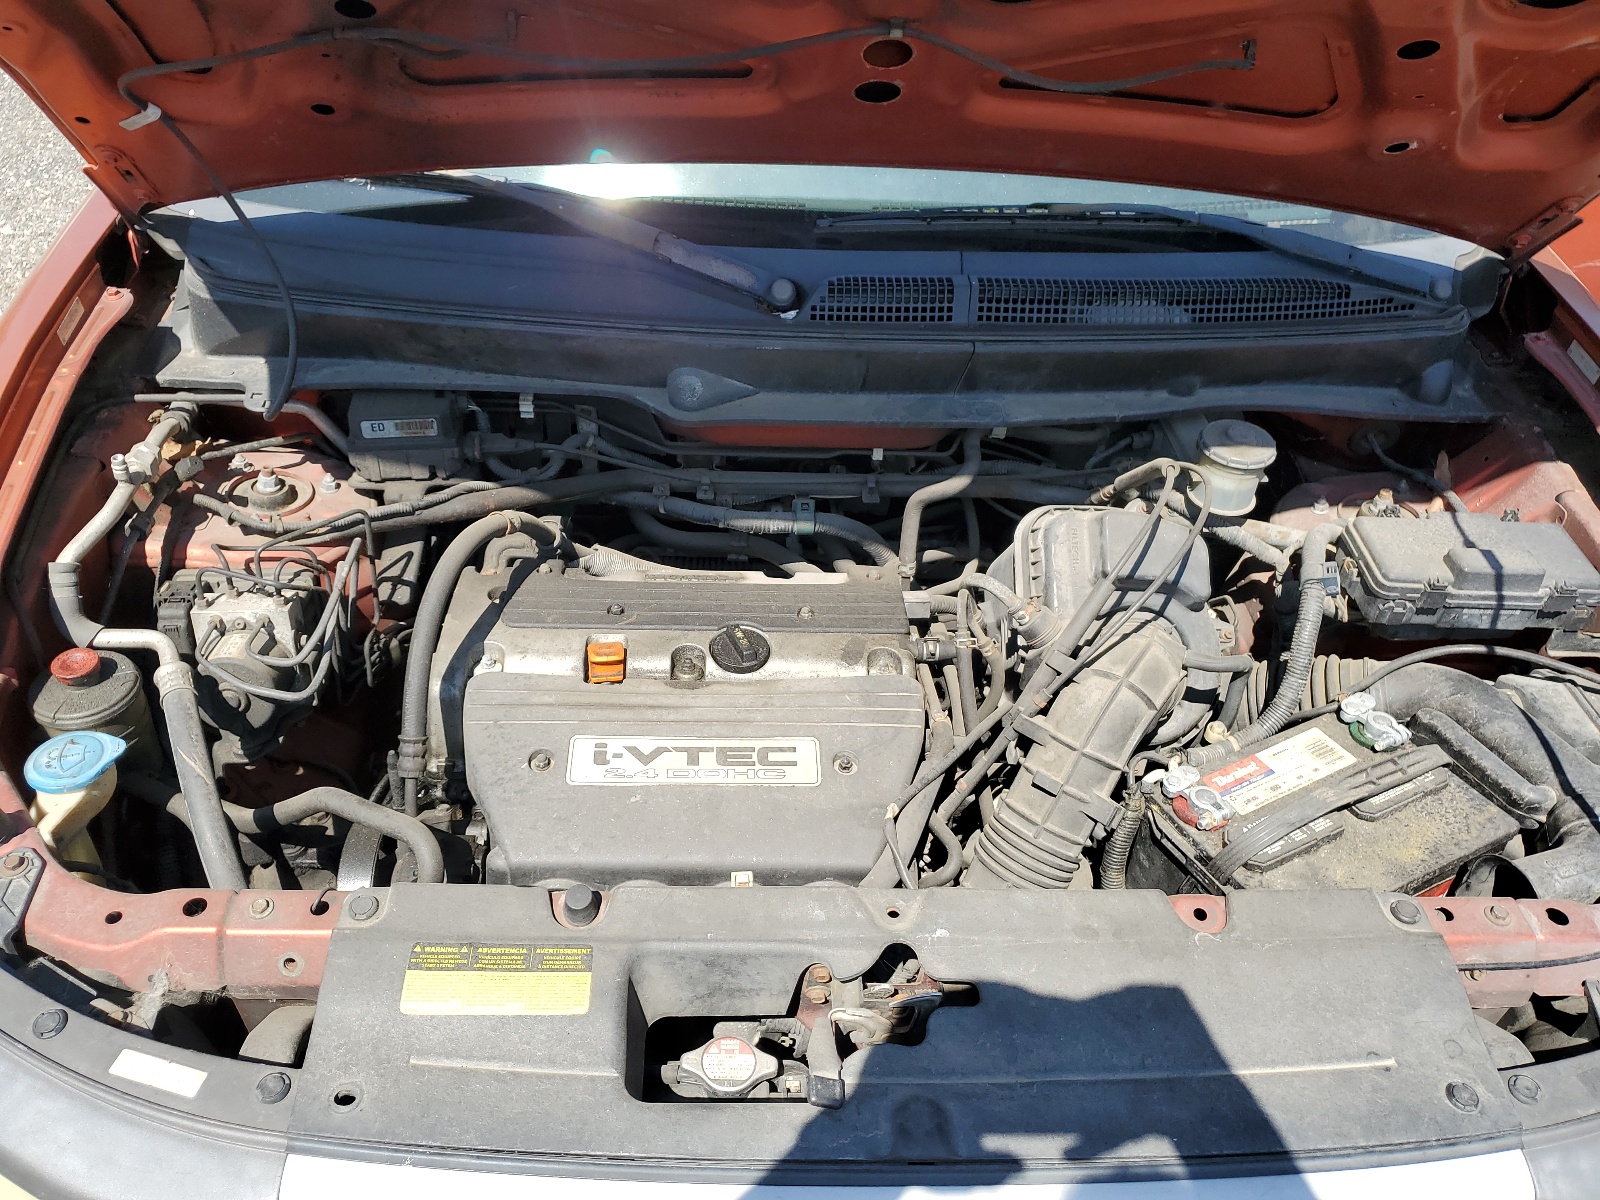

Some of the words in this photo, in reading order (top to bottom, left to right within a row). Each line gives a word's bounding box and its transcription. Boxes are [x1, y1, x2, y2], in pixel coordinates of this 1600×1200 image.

[370, 422, 385, 432] ED
[593, 742, 798, 766] i-VTEC
[603, 767, 659, 779] 2.4
[666, 768, 787, 780] DOHC
